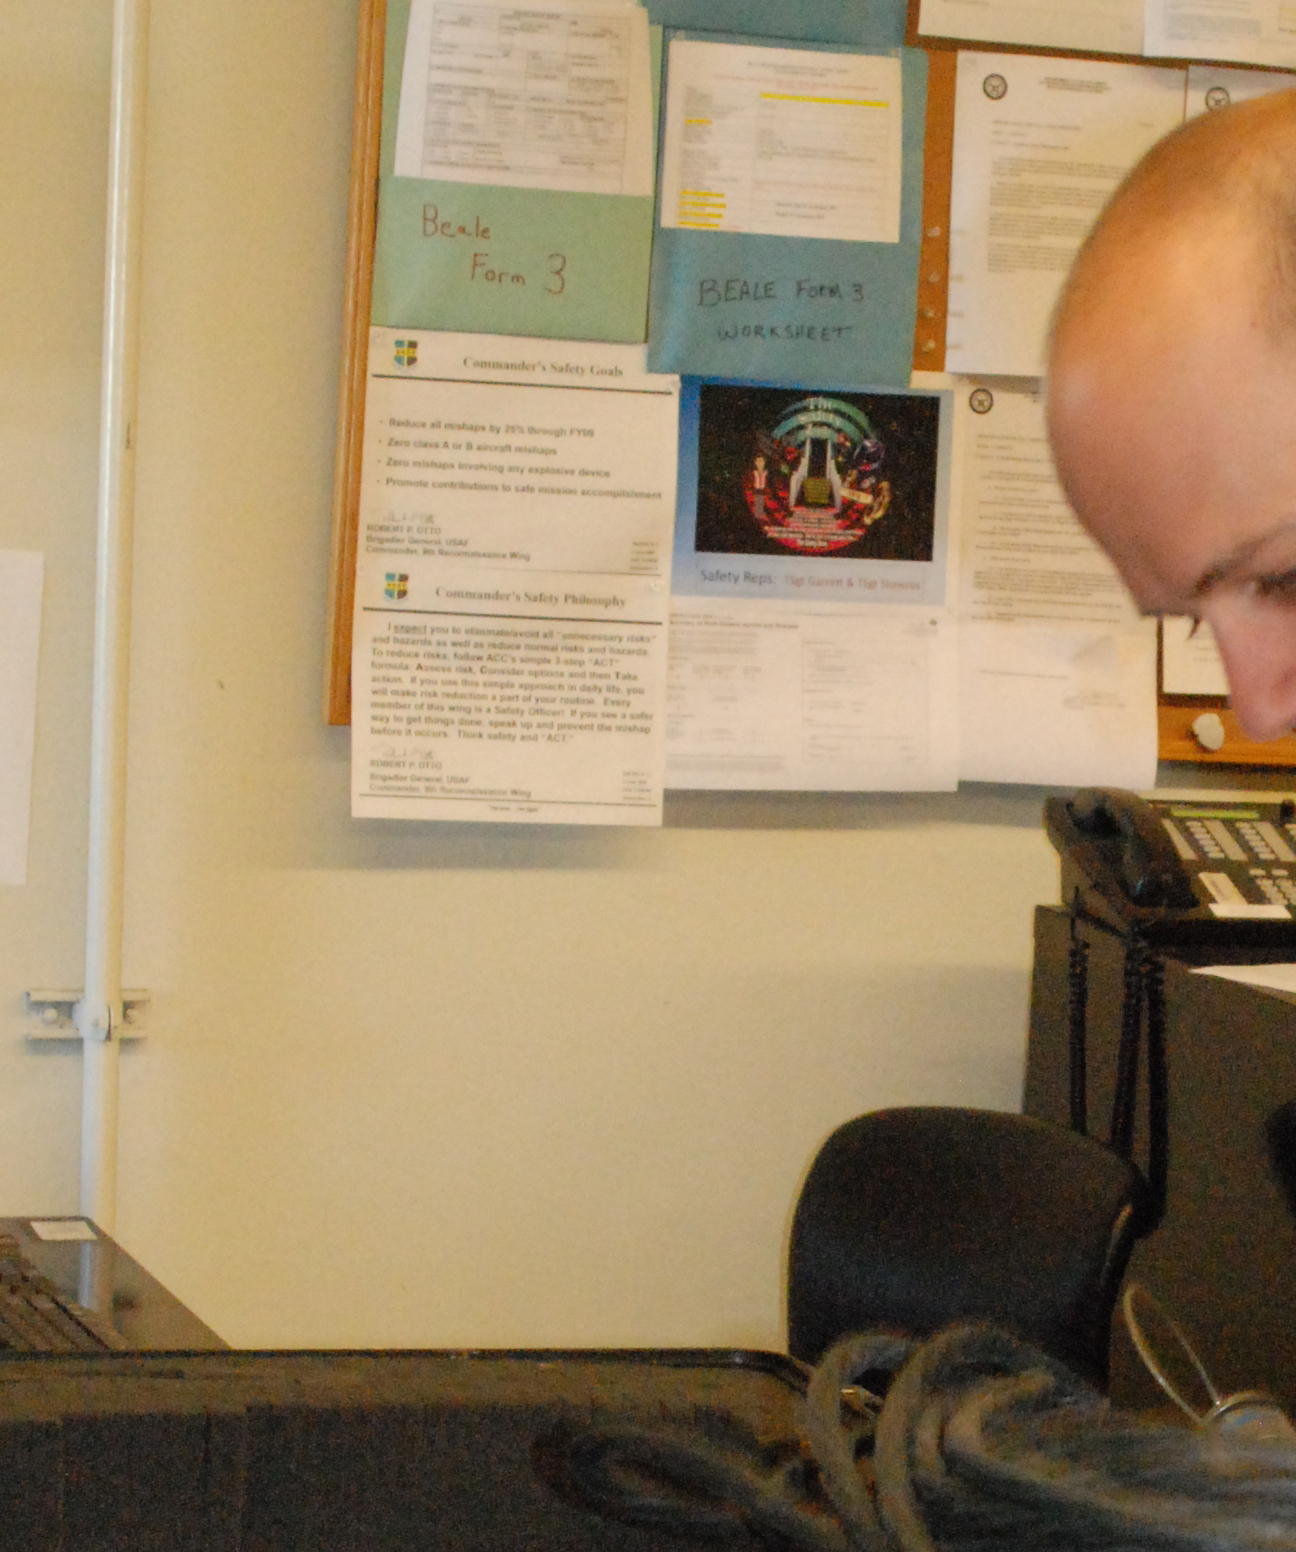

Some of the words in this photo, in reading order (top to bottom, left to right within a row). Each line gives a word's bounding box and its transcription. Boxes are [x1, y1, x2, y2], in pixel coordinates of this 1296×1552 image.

[423, 203, 491, 240] Beale
[471, 253, 526, 285] Form
[546, 253, 567, 294] 3
[698, 278, 776, 307] BEALE
[852, 283, 865, 301] 3
[717, 325, 852, 342] WORKSHEET
[463, 357, 546, 371] Commander's
[550, 362, 585, 375] Safety
[589, 364, 622, 375] Goals
[388, 417, 426, 428] Reduce
[429, 419, 441, 429] all
[444, 420, 486, 433] mishaps
[488, 422, 500, 433] by
[504, 423, 524, 433] 25%
[527, 424, 566, 436] through
[569, 426, 594, 436] FY09
[387, 438, 410, 447] Zero
[413, 439, 439, 448] class
[476, 442, 512, 452] aircraft
[514, 444, 557, 456] mishaps
[386, 458, 409, 467] Zero
[412, 459, 454, 470] mishaps
[458, 461, 504, 473] involving
[506, 465, 524, 474] any
[527, 464, 575, 476] explosive
[578, 467, 610, 476] device
[385, 477, 428, 487] Promote
[431, 479, 498, 490] contributions
[501, 483, 511, 491] to
[514, 483, 535, 492] safe
[537, 484, 577, 494] mission
[580, 486, 662, 500] accomplishment
[700, 569, 739, 583] Safety
[435, 586, 520, 601] Commander's
[524, 591, 558, 605] Safety
[564, 593, 624, 608] Philosophy
